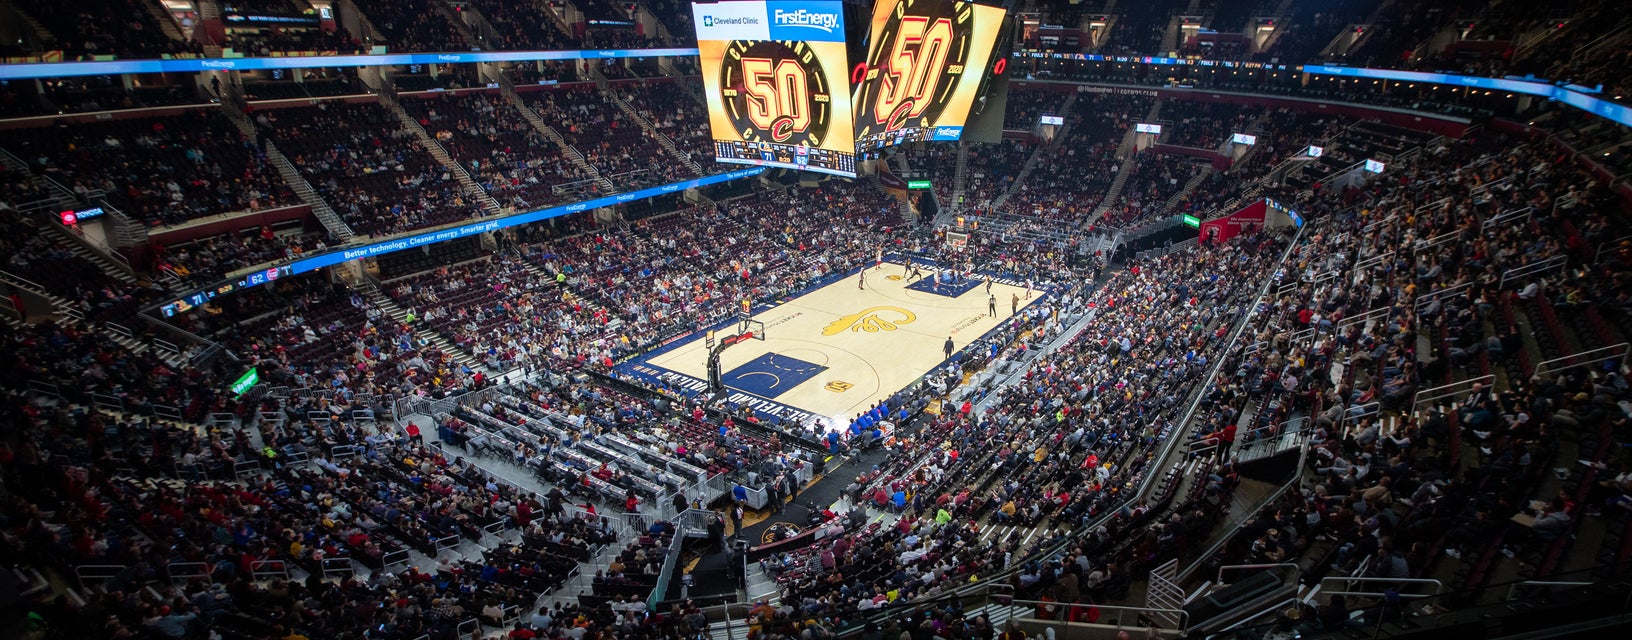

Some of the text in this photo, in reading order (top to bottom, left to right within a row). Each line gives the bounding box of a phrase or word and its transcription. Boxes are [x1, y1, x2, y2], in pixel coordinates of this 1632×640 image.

[714, 17, 759, 25] Cleveland Clinic
[775, 9, 840, 29] FirstEnergy
[202, 60, 235, 68] FirstEnergy
[947, 65, 963, 74] 2020
[873, 15, 954, 125] 50
[741, 57, 811, 133] 50
[814, 93, 830, 102] 2020
[764, 152, 772, 161] 71
[796, 156, 806, 165] 62
[75, 207, 104, 219] TOYOTA
[344, 220, 500, 259] Better technology. Cleaner energy. Smarter grid.
[251, 274, 264, 285] 62
[191, 294, 203, 305] 71
